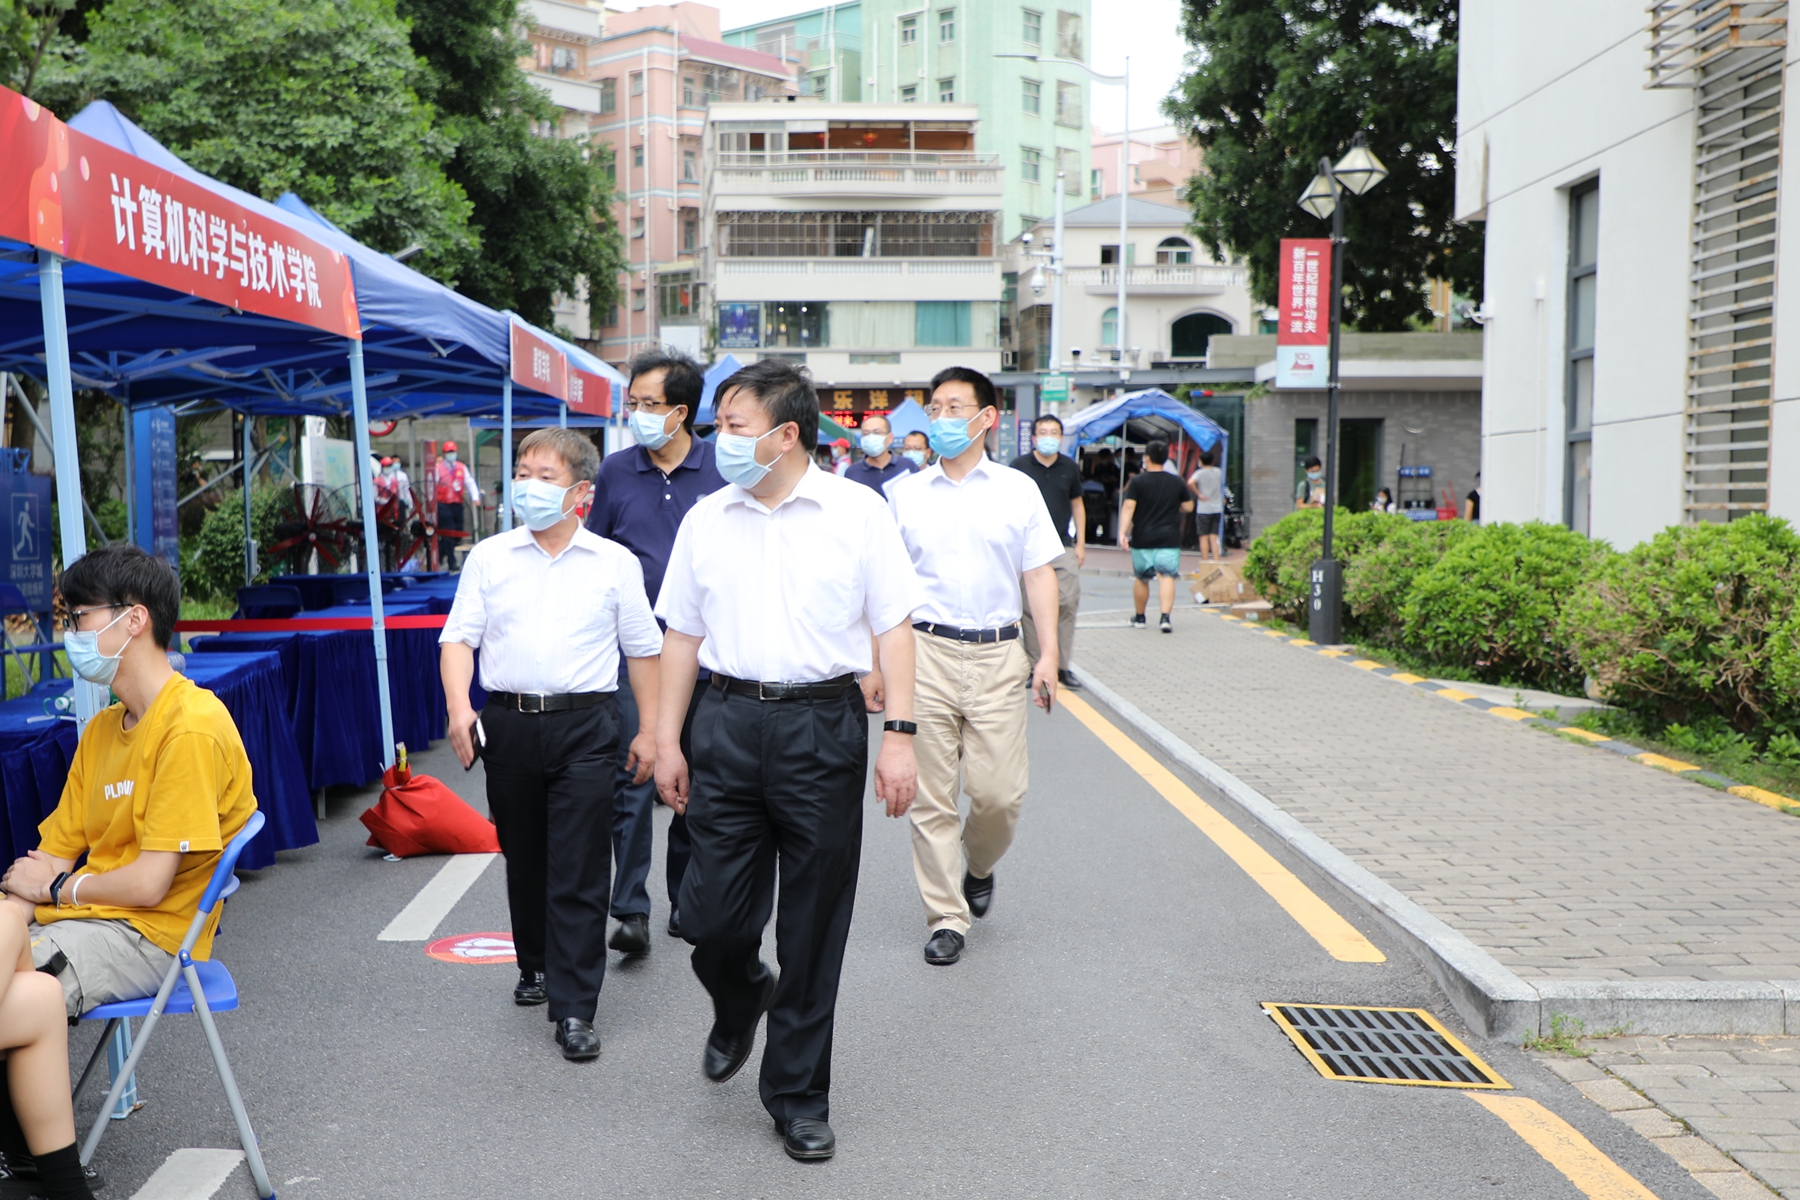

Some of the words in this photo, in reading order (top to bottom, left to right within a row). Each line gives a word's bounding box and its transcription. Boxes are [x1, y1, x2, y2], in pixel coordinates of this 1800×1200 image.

[111, 173, 322, 308] 计算机科学与技术学院
[1291, 247, 1305, 333] 新百年世界一流
